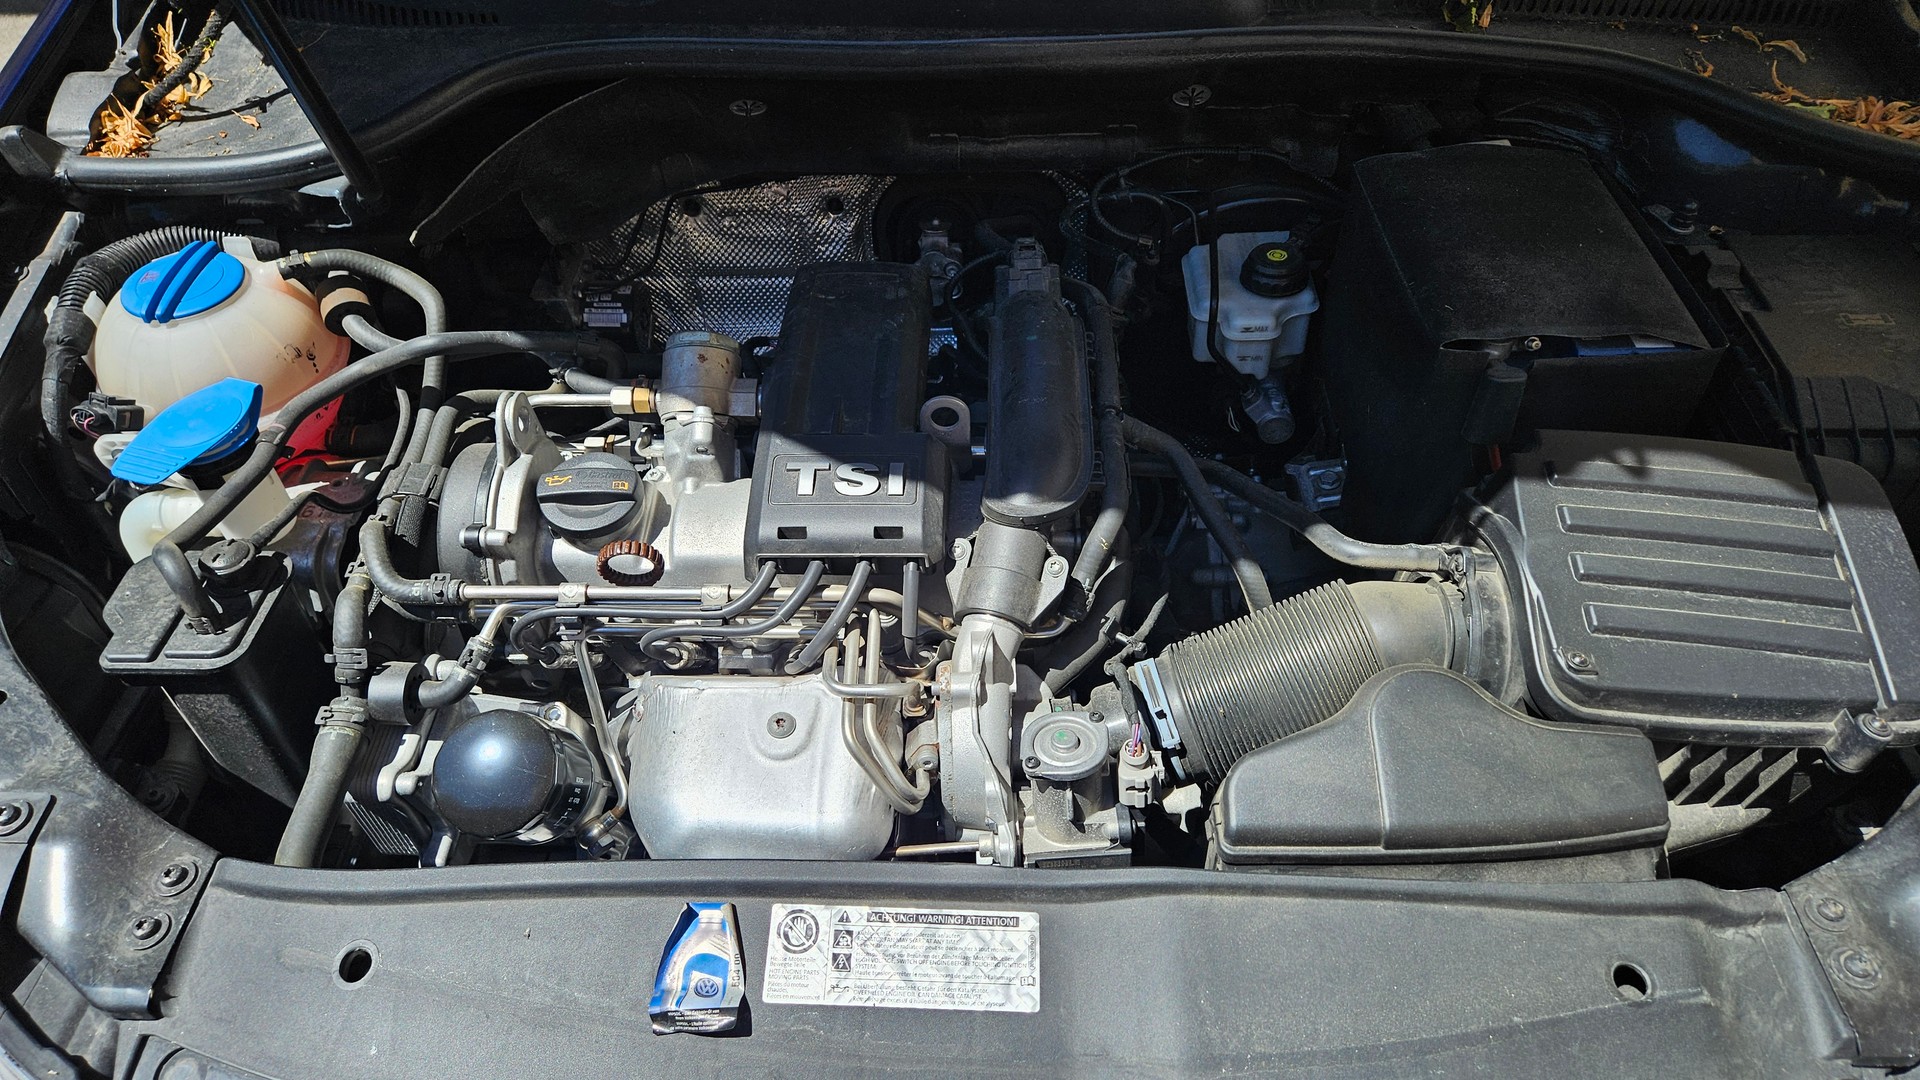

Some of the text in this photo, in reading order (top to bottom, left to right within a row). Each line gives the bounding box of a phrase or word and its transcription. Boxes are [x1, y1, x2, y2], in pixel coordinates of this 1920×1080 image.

[786, 462, 904, 496] TSI
[871, 912, 1016, 927] ACHTUNG! WARNING! ATTENTION!
